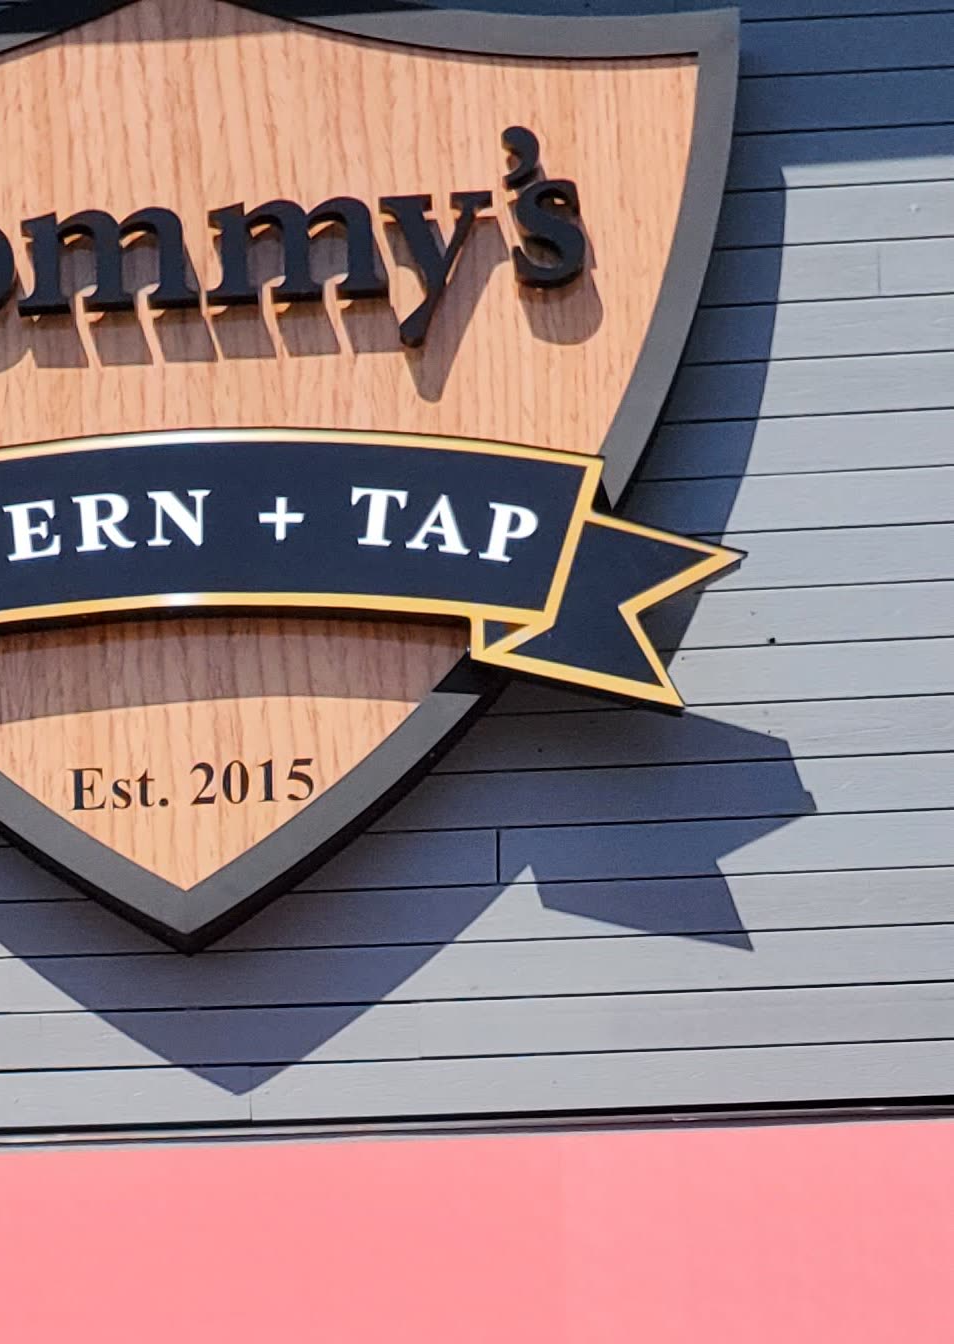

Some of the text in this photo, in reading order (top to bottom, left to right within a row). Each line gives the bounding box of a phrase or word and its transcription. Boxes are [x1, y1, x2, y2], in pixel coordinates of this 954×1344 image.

[257, 498, 304, 543] +
[350, 486, 540, 564] TAP
[69, 757, 315, 813] Est. 2015
